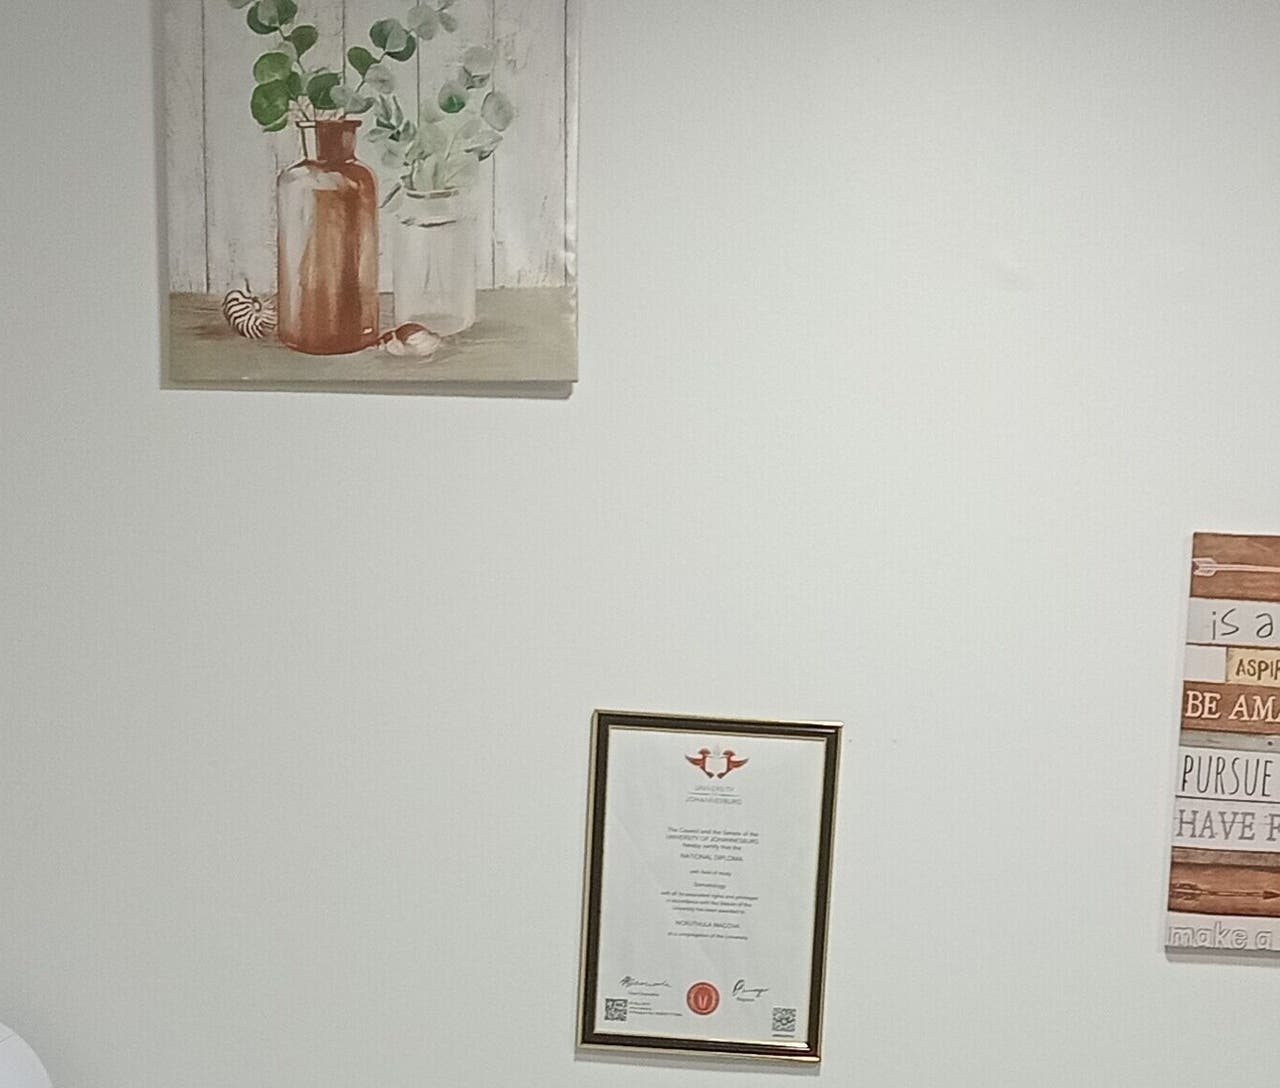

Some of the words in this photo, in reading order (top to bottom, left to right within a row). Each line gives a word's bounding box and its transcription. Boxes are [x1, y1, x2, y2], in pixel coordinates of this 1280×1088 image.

[1211, 608, 1240, 641] is
[1255, 612, 1274, 639] a
[1185, 690, 1220, 720] BE
[1181, 754, 1273, 797] PURSUE
[1176, 811, 1256, 841] HAVE
[1168, 925, 1247, 949] make
[1255, 932, 1273, 952] a
